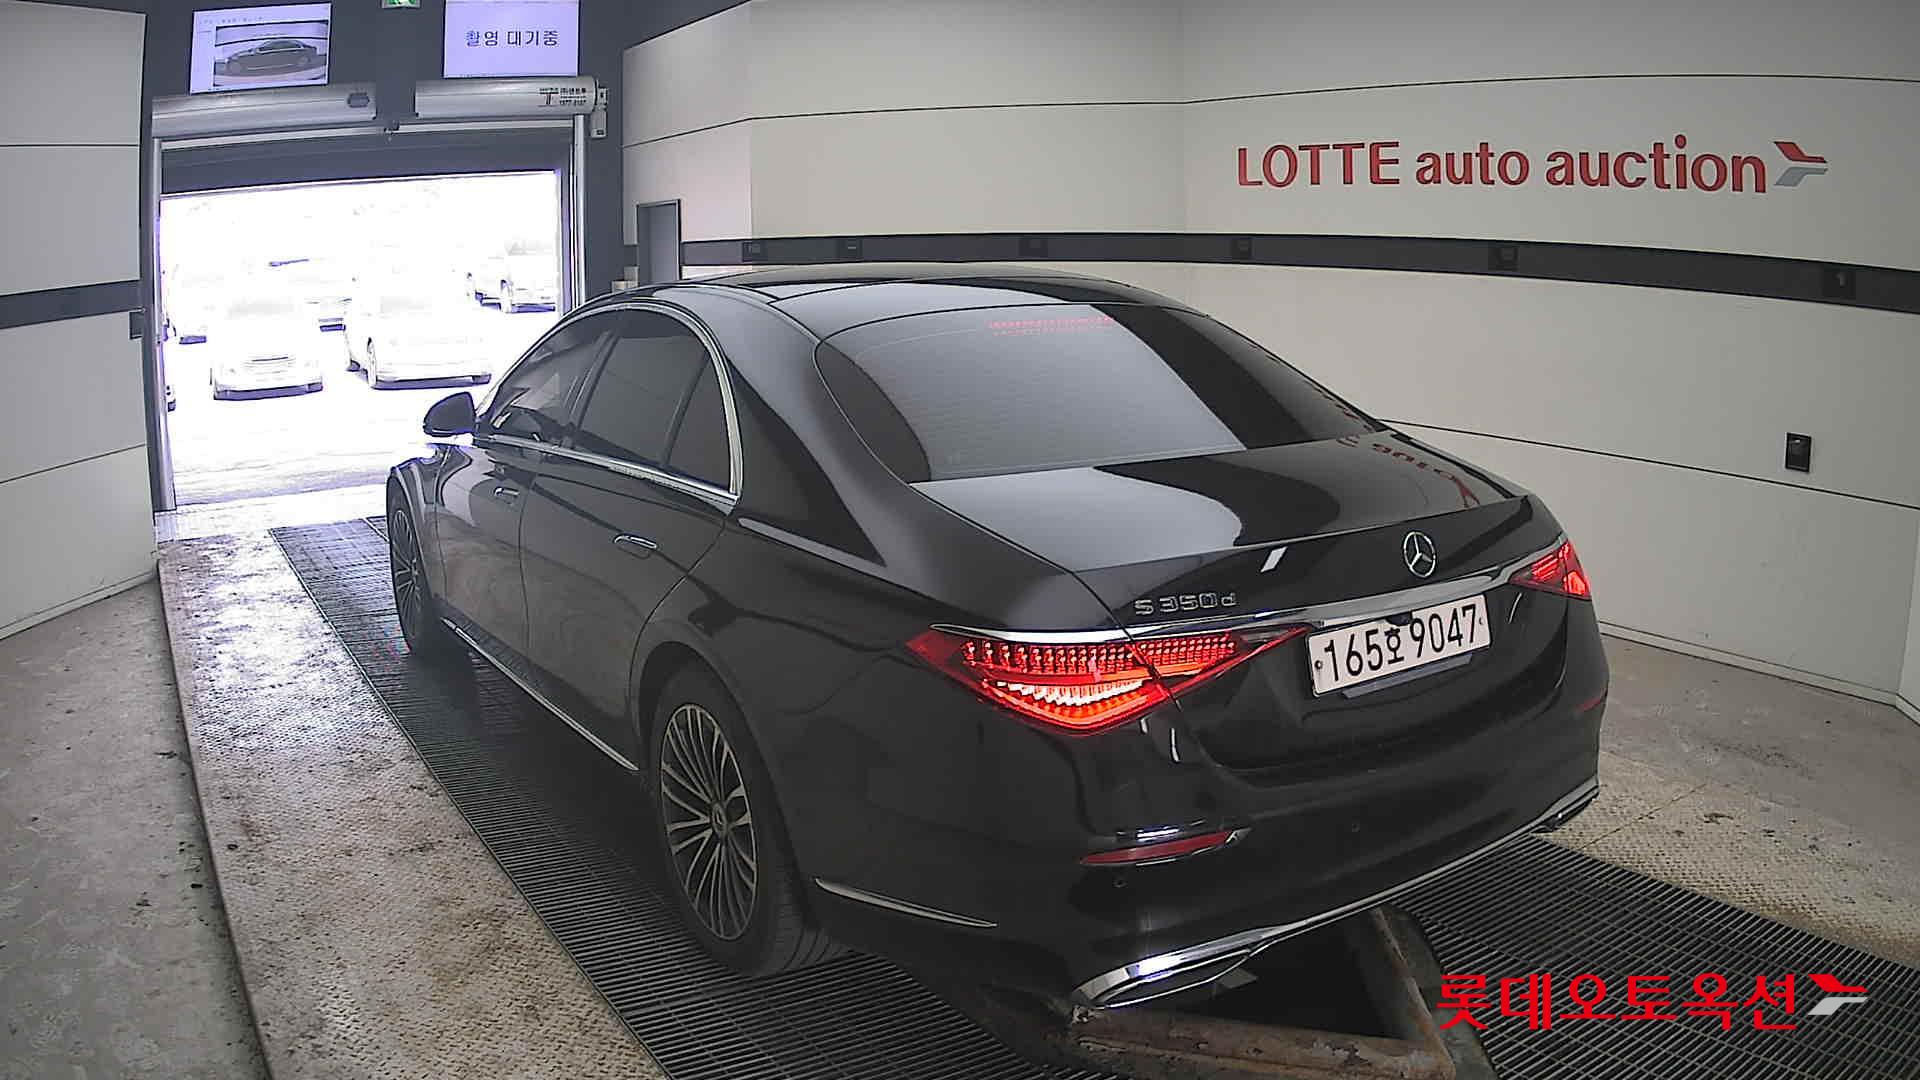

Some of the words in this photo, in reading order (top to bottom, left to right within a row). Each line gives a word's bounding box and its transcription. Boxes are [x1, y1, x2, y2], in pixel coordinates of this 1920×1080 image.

[465, 30, 499, 47] 촬영
[507, 30, 558, 47] 대기중
[1238, 141, 1400, 187] LOTTE
[1415, 142, 1530, 186] auto
[1545, 134, 1767, 194] auction
[1134, 599, 1154, 615] S
[1159, 592, 1238, 613] 350d
[1409, 603, 1477, 659] 9047
